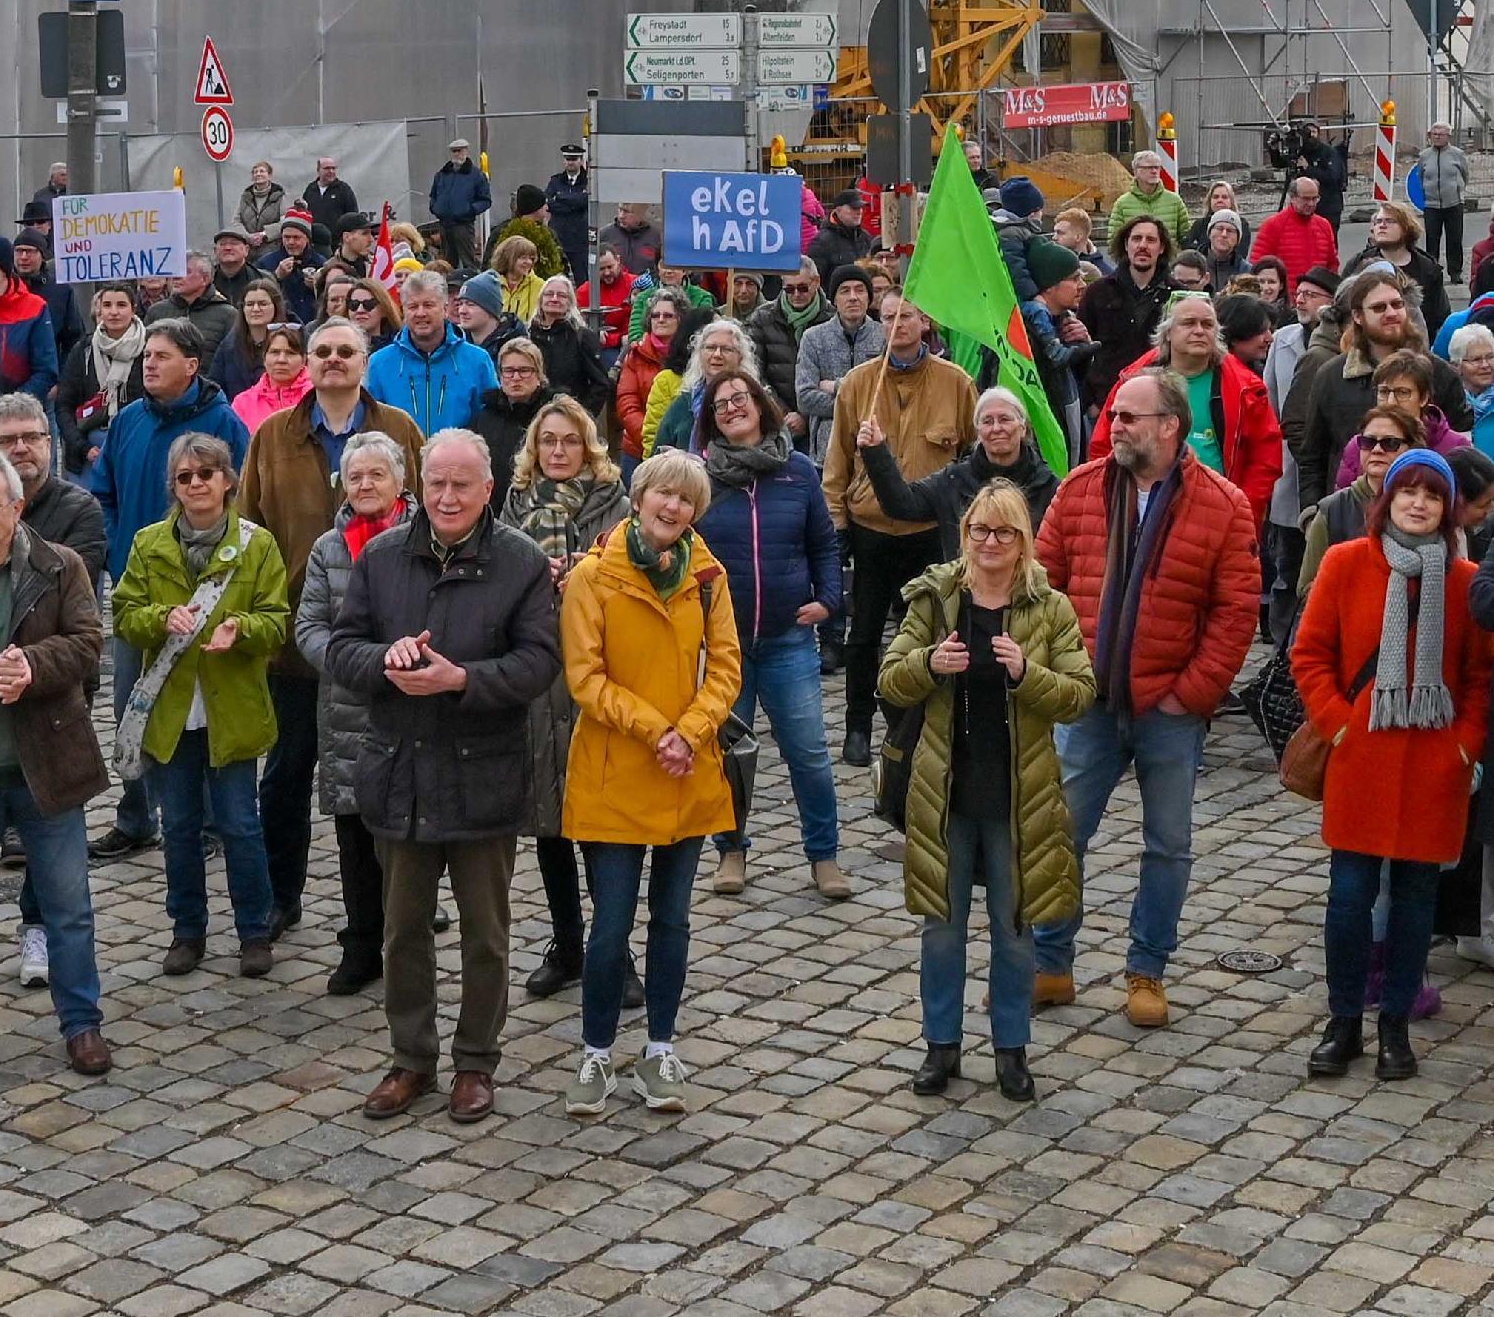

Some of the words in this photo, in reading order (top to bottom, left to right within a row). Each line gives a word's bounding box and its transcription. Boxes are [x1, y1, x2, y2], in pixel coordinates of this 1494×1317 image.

[649, 19, 687, 31] Freystadt
[722, 19, 730, 29] 15
[649, 33, 702, 44] Lampersdorf
[722, 55, 729, 66] 25
[647, 69, 705, 81] Seligenporten
[1005, 88, 1046, 115] M&S
[1089, 82, 1128, 110] M&S
[1027, 110, 1107, 126] m-s-geruestbau.de
[208, 121, 227, 145] 30
[60, 210, 160, 240] DEMOKATIE
[65, 240, 92, 253] UND
[60, 247, 173, 281] TOLERANZ
